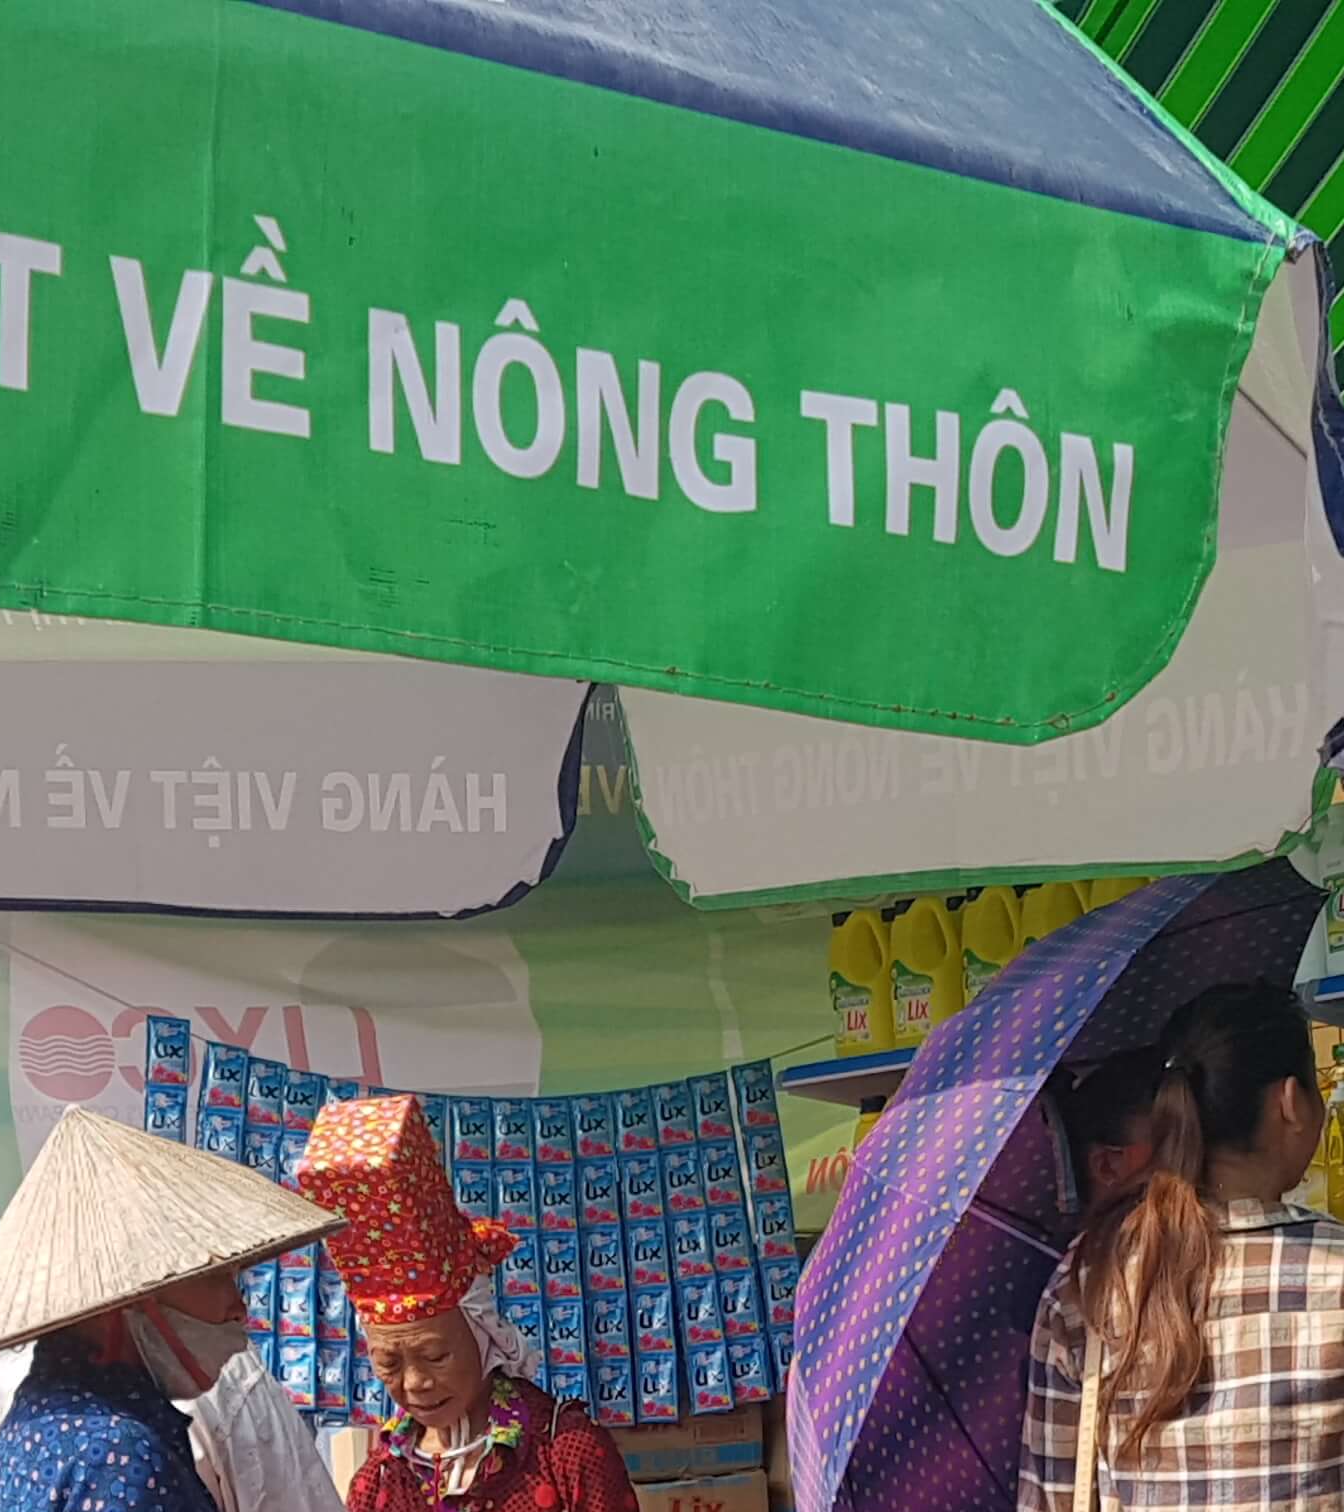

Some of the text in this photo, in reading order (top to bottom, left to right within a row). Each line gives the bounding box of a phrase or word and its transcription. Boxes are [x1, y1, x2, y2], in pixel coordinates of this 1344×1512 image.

[109, 217, 309, 438] VỀ
[367, 299, 757, 512] NÔNG
[801, 389, 1133, 572] THÔN
